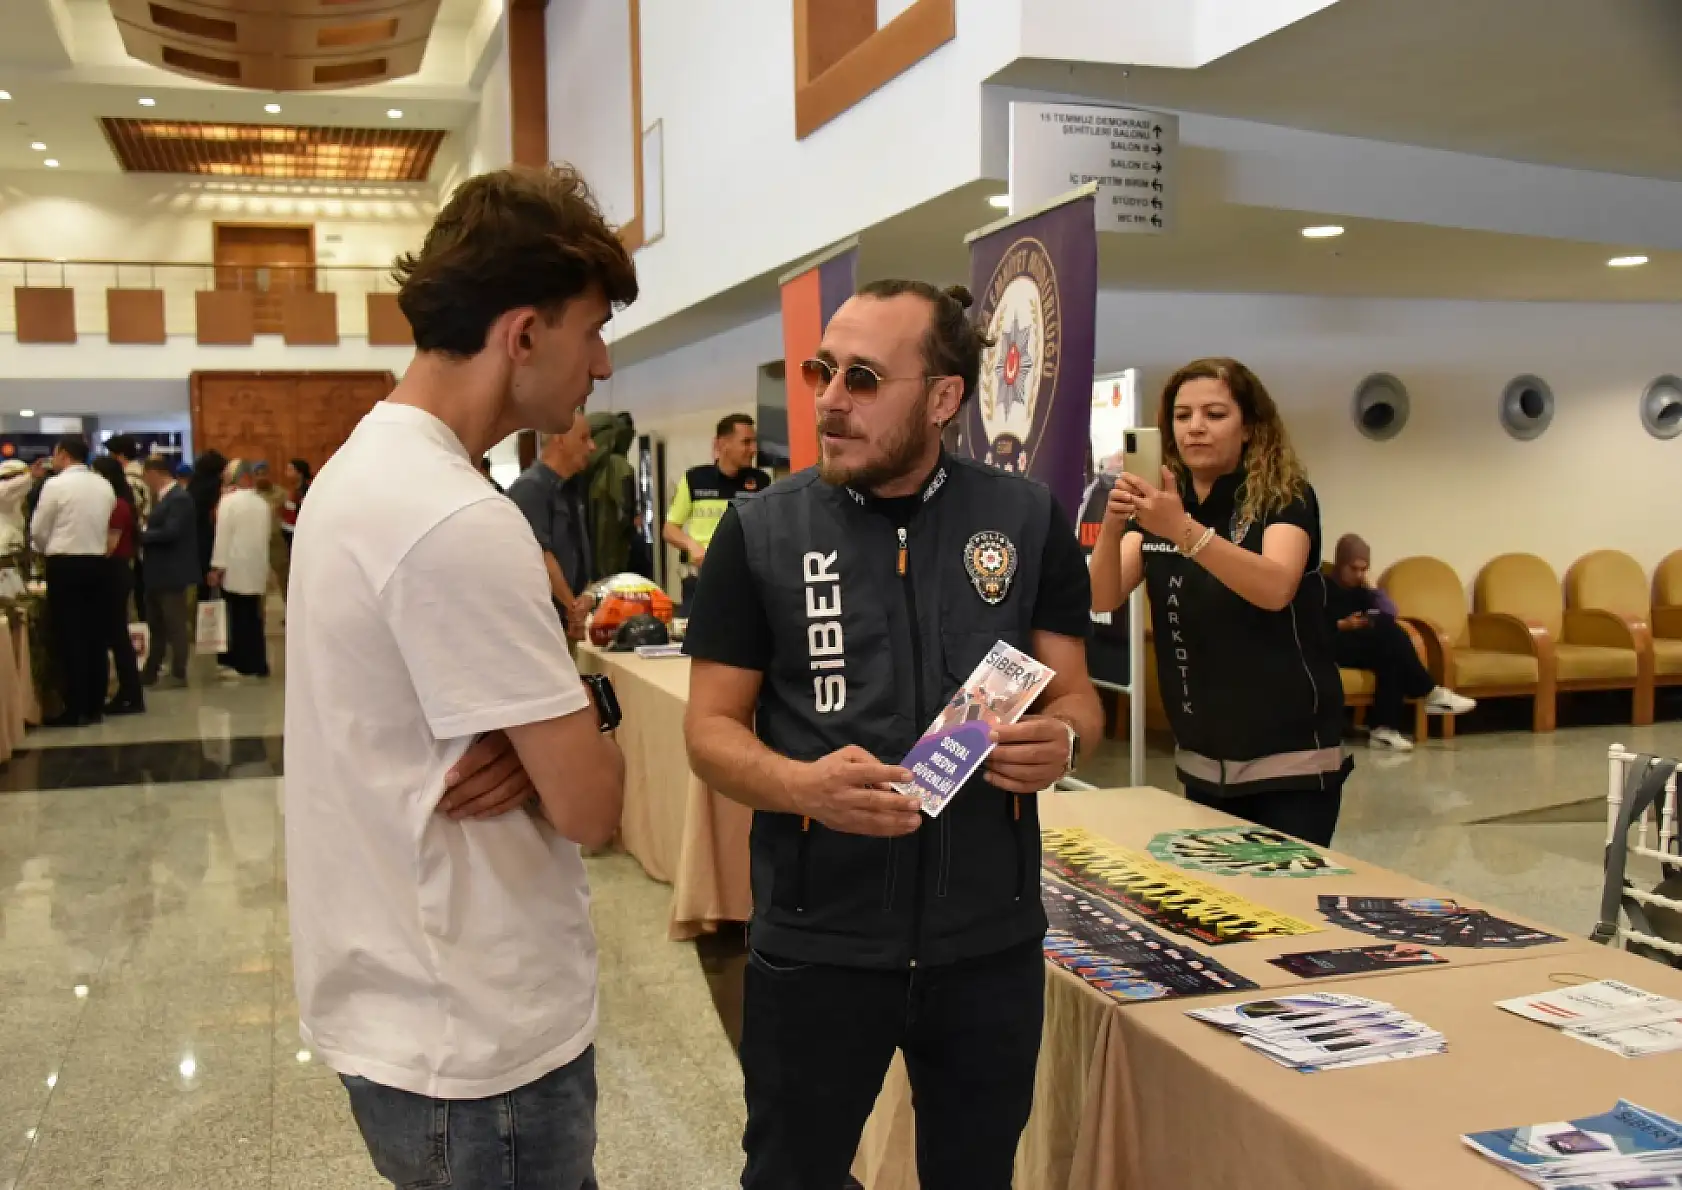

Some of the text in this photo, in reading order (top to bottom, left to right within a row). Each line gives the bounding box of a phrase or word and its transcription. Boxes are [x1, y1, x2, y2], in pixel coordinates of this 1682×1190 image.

[1053, 113, 1093, 124] TEMMUZ
[1113, 128, 1150, 140] SALONU
[1110, 141, 1141, 152] SALON
[1110, 159, 1141, 170] SALON
